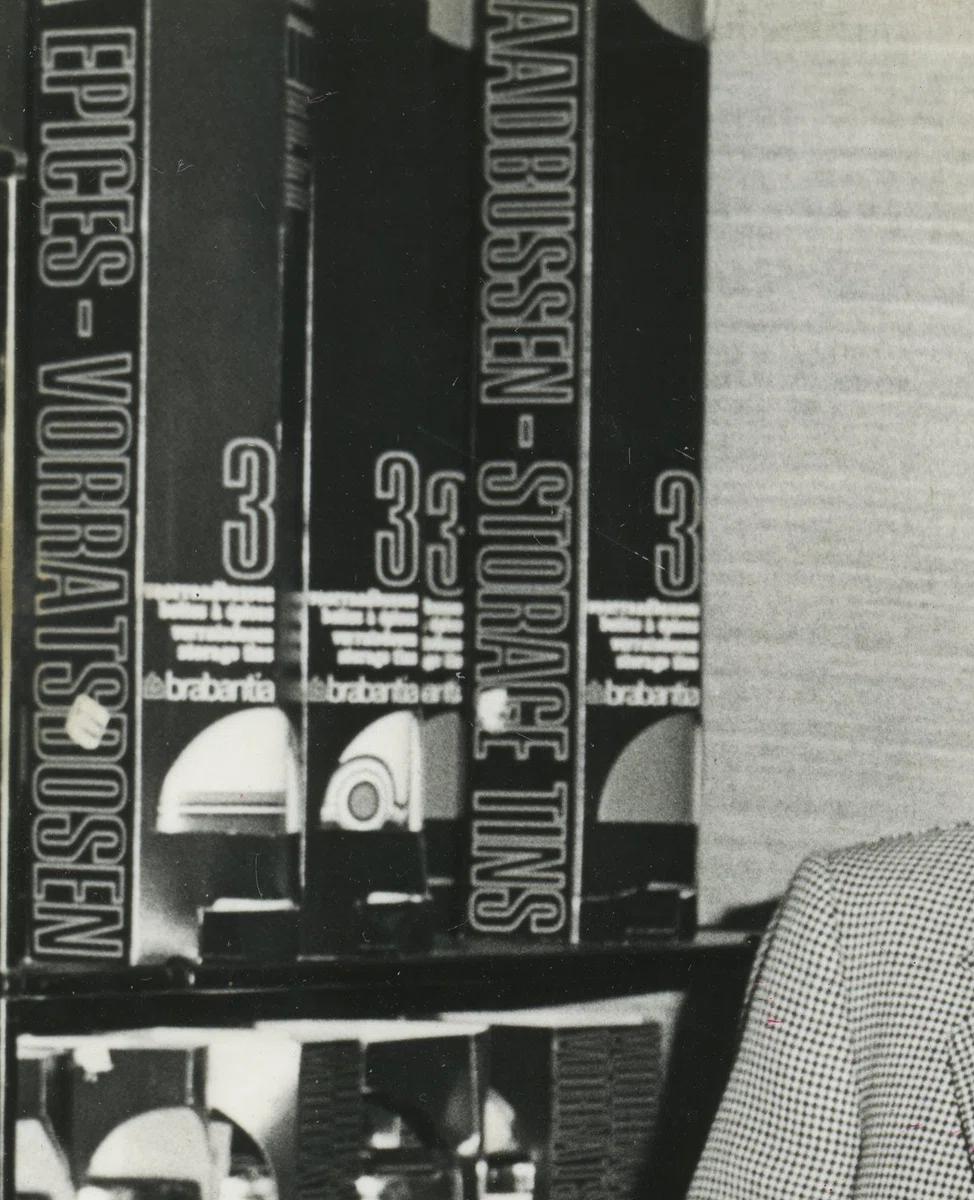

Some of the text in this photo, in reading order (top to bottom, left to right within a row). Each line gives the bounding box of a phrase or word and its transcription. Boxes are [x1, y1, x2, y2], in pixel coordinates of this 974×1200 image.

[40, 26, 138, 288] EPICES
[221, 437, 277, 580] 3
[374, 451, 421, 587] 3
[655, 469, 700, 597] 3
[32, 351, 134, 960] VORRATSDOSEN
[472, 460, 574, 761] STORAGE
[164, 669, 276, 703] brabantia
[324, 673, 420, 705] brabantia
[467, 781, 568, 934] TINS
